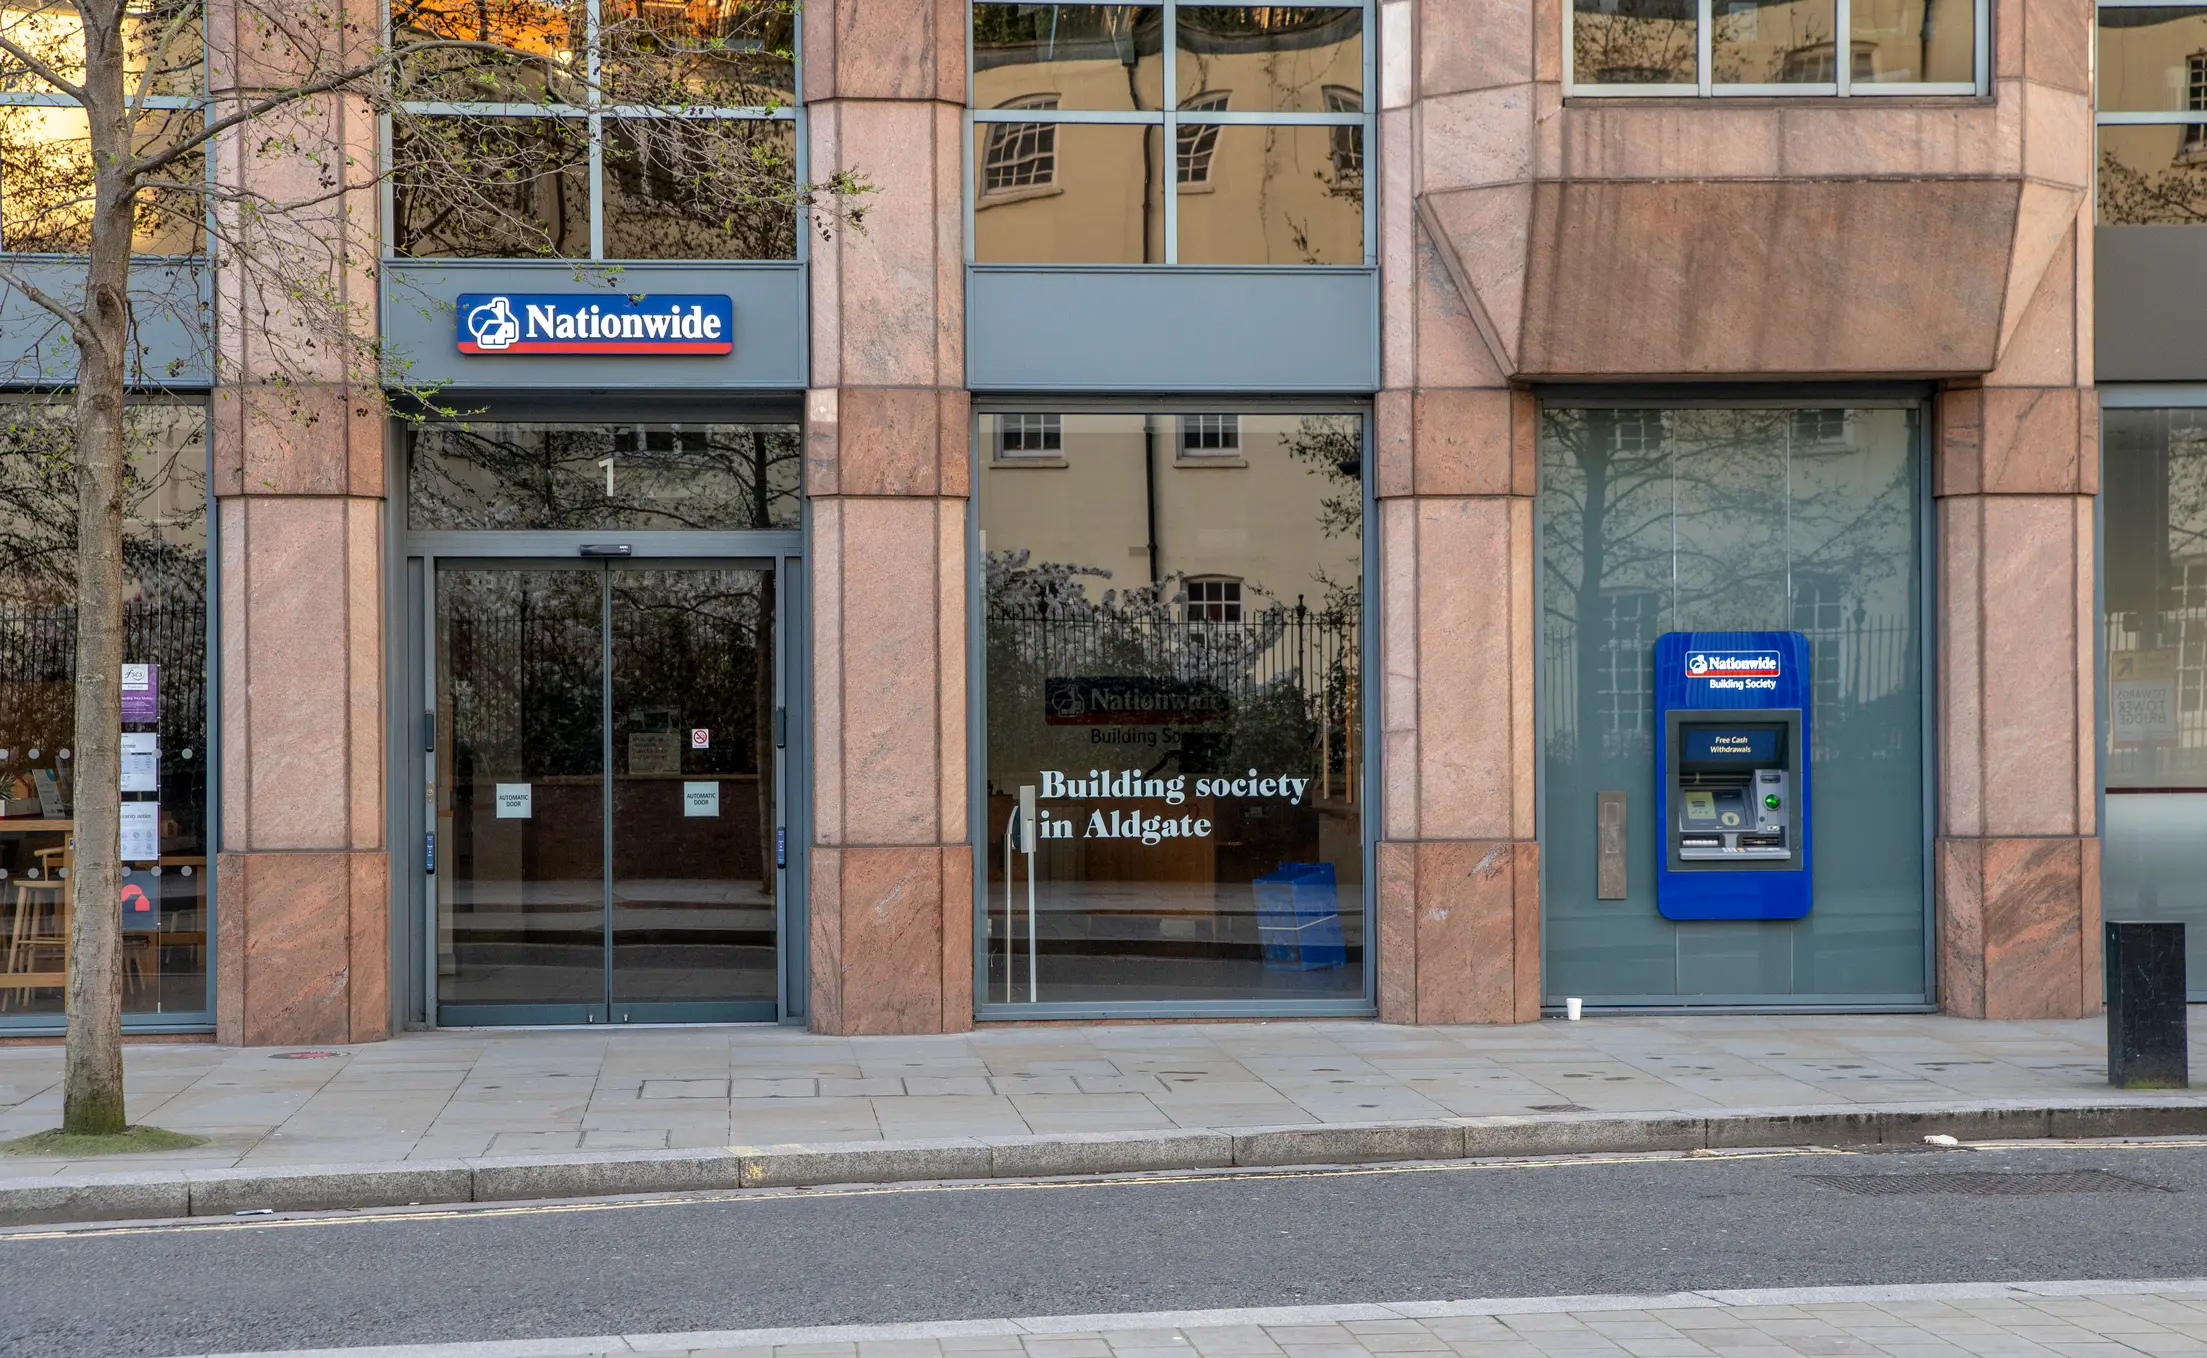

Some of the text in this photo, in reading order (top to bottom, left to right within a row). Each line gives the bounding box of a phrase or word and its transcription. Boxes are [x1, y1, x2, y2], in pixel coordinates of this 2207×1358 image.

[525, 304, 721, 340] Nationwide
[597, 457, 614, 497] 1
[1709, 656, 1777, 670] Nationwide
[1709, 679, 1777, 690] Building Society
[1091, 728, 1157, 747] Building
[1715, 736, 1748, 744] Free Cash
[1040, 768, 1309, 805] Building society
[1040, 809, 1213, 846] in Aldgate
